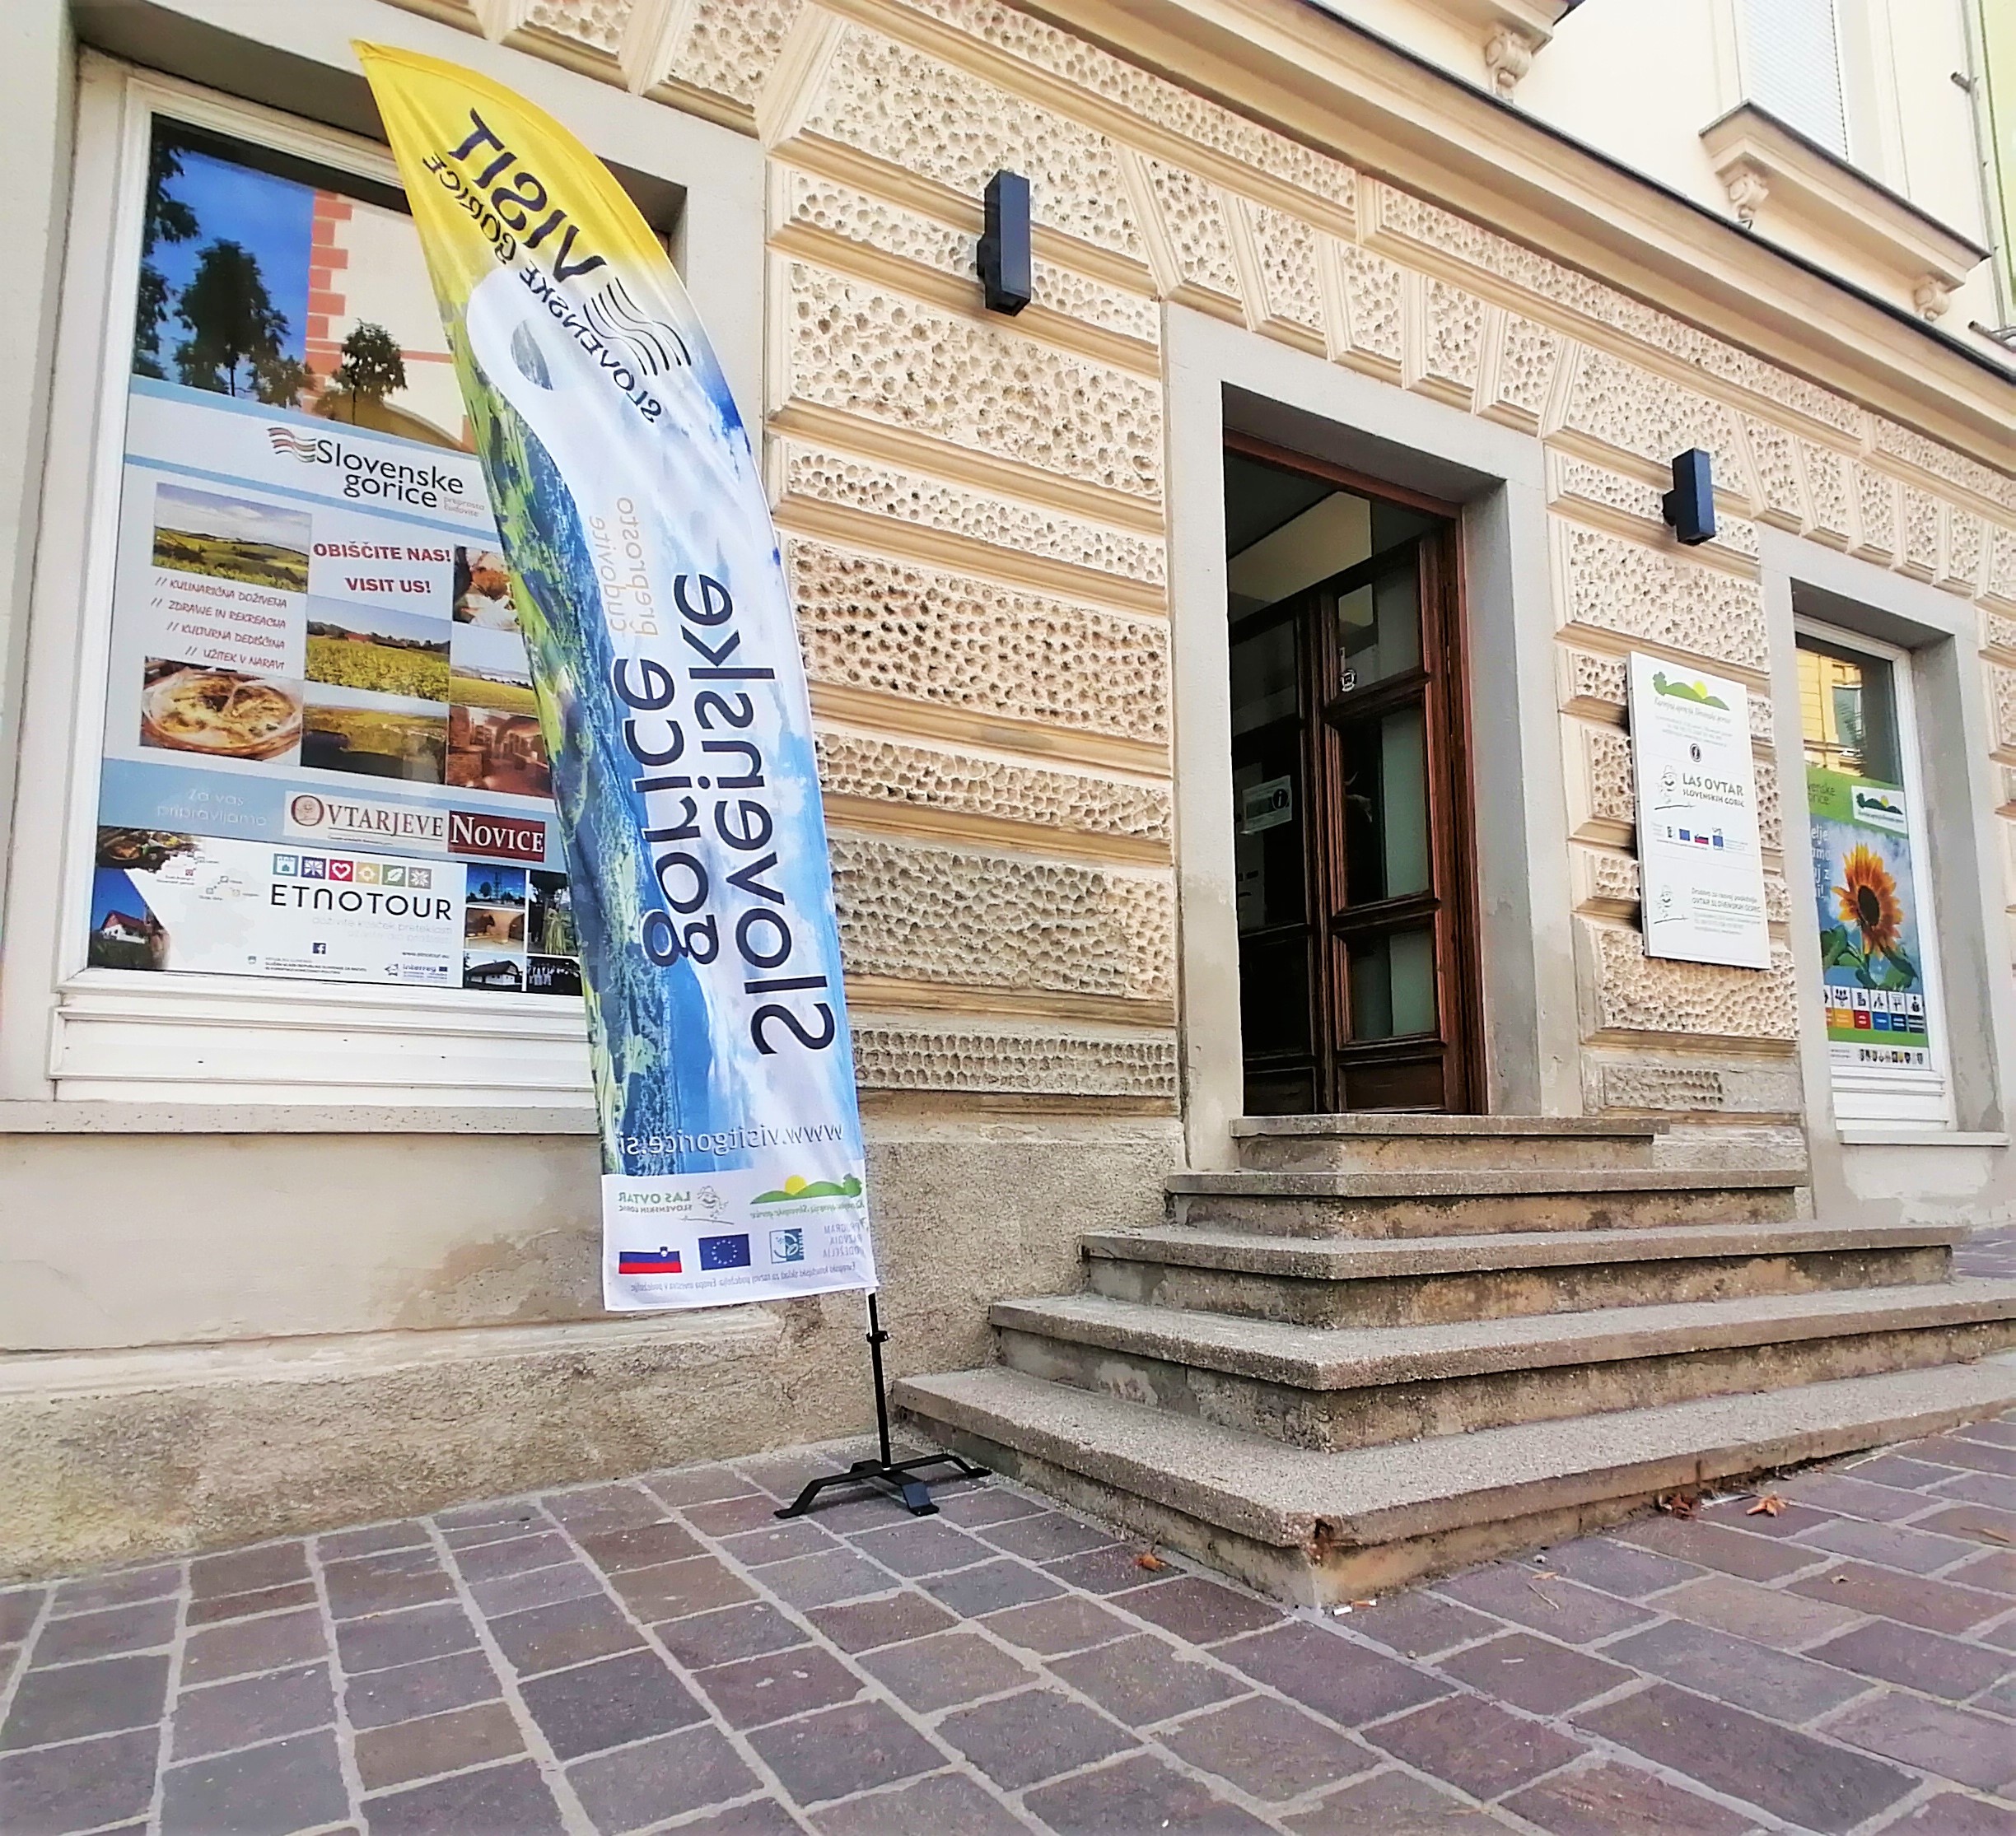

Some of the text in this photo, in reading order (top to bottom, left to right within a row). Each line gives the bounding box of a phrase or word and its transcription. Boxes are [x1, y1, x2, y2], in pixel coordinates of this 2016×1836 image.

[315, 439, 464, 495] Slovenske
[343, 473, 437, 508] gorice
[313, 540, 451, 562] OBIŠČITE NAS!
[169, 579, 236, 599] KULINARIČNA
[344, 577, 432, 594] VISIT US!
[214, 608, 226, 619] IN
[228, 611, 287, 630] REKREACIJA
[180, 623, 232, 641] KULTURNA
[234, 632, 285, 650] DEDIŠČINA
[203, 648, 238, 664] UŽITEK
[240, 654, 247, 664] V
[248, 656, 285, 671] NARAVI
[1682, 772, 1744, 797] LAS OVTAR
[188, 788, 245, 806] Za vas
[450, 813, 545, 854] NOVICE
